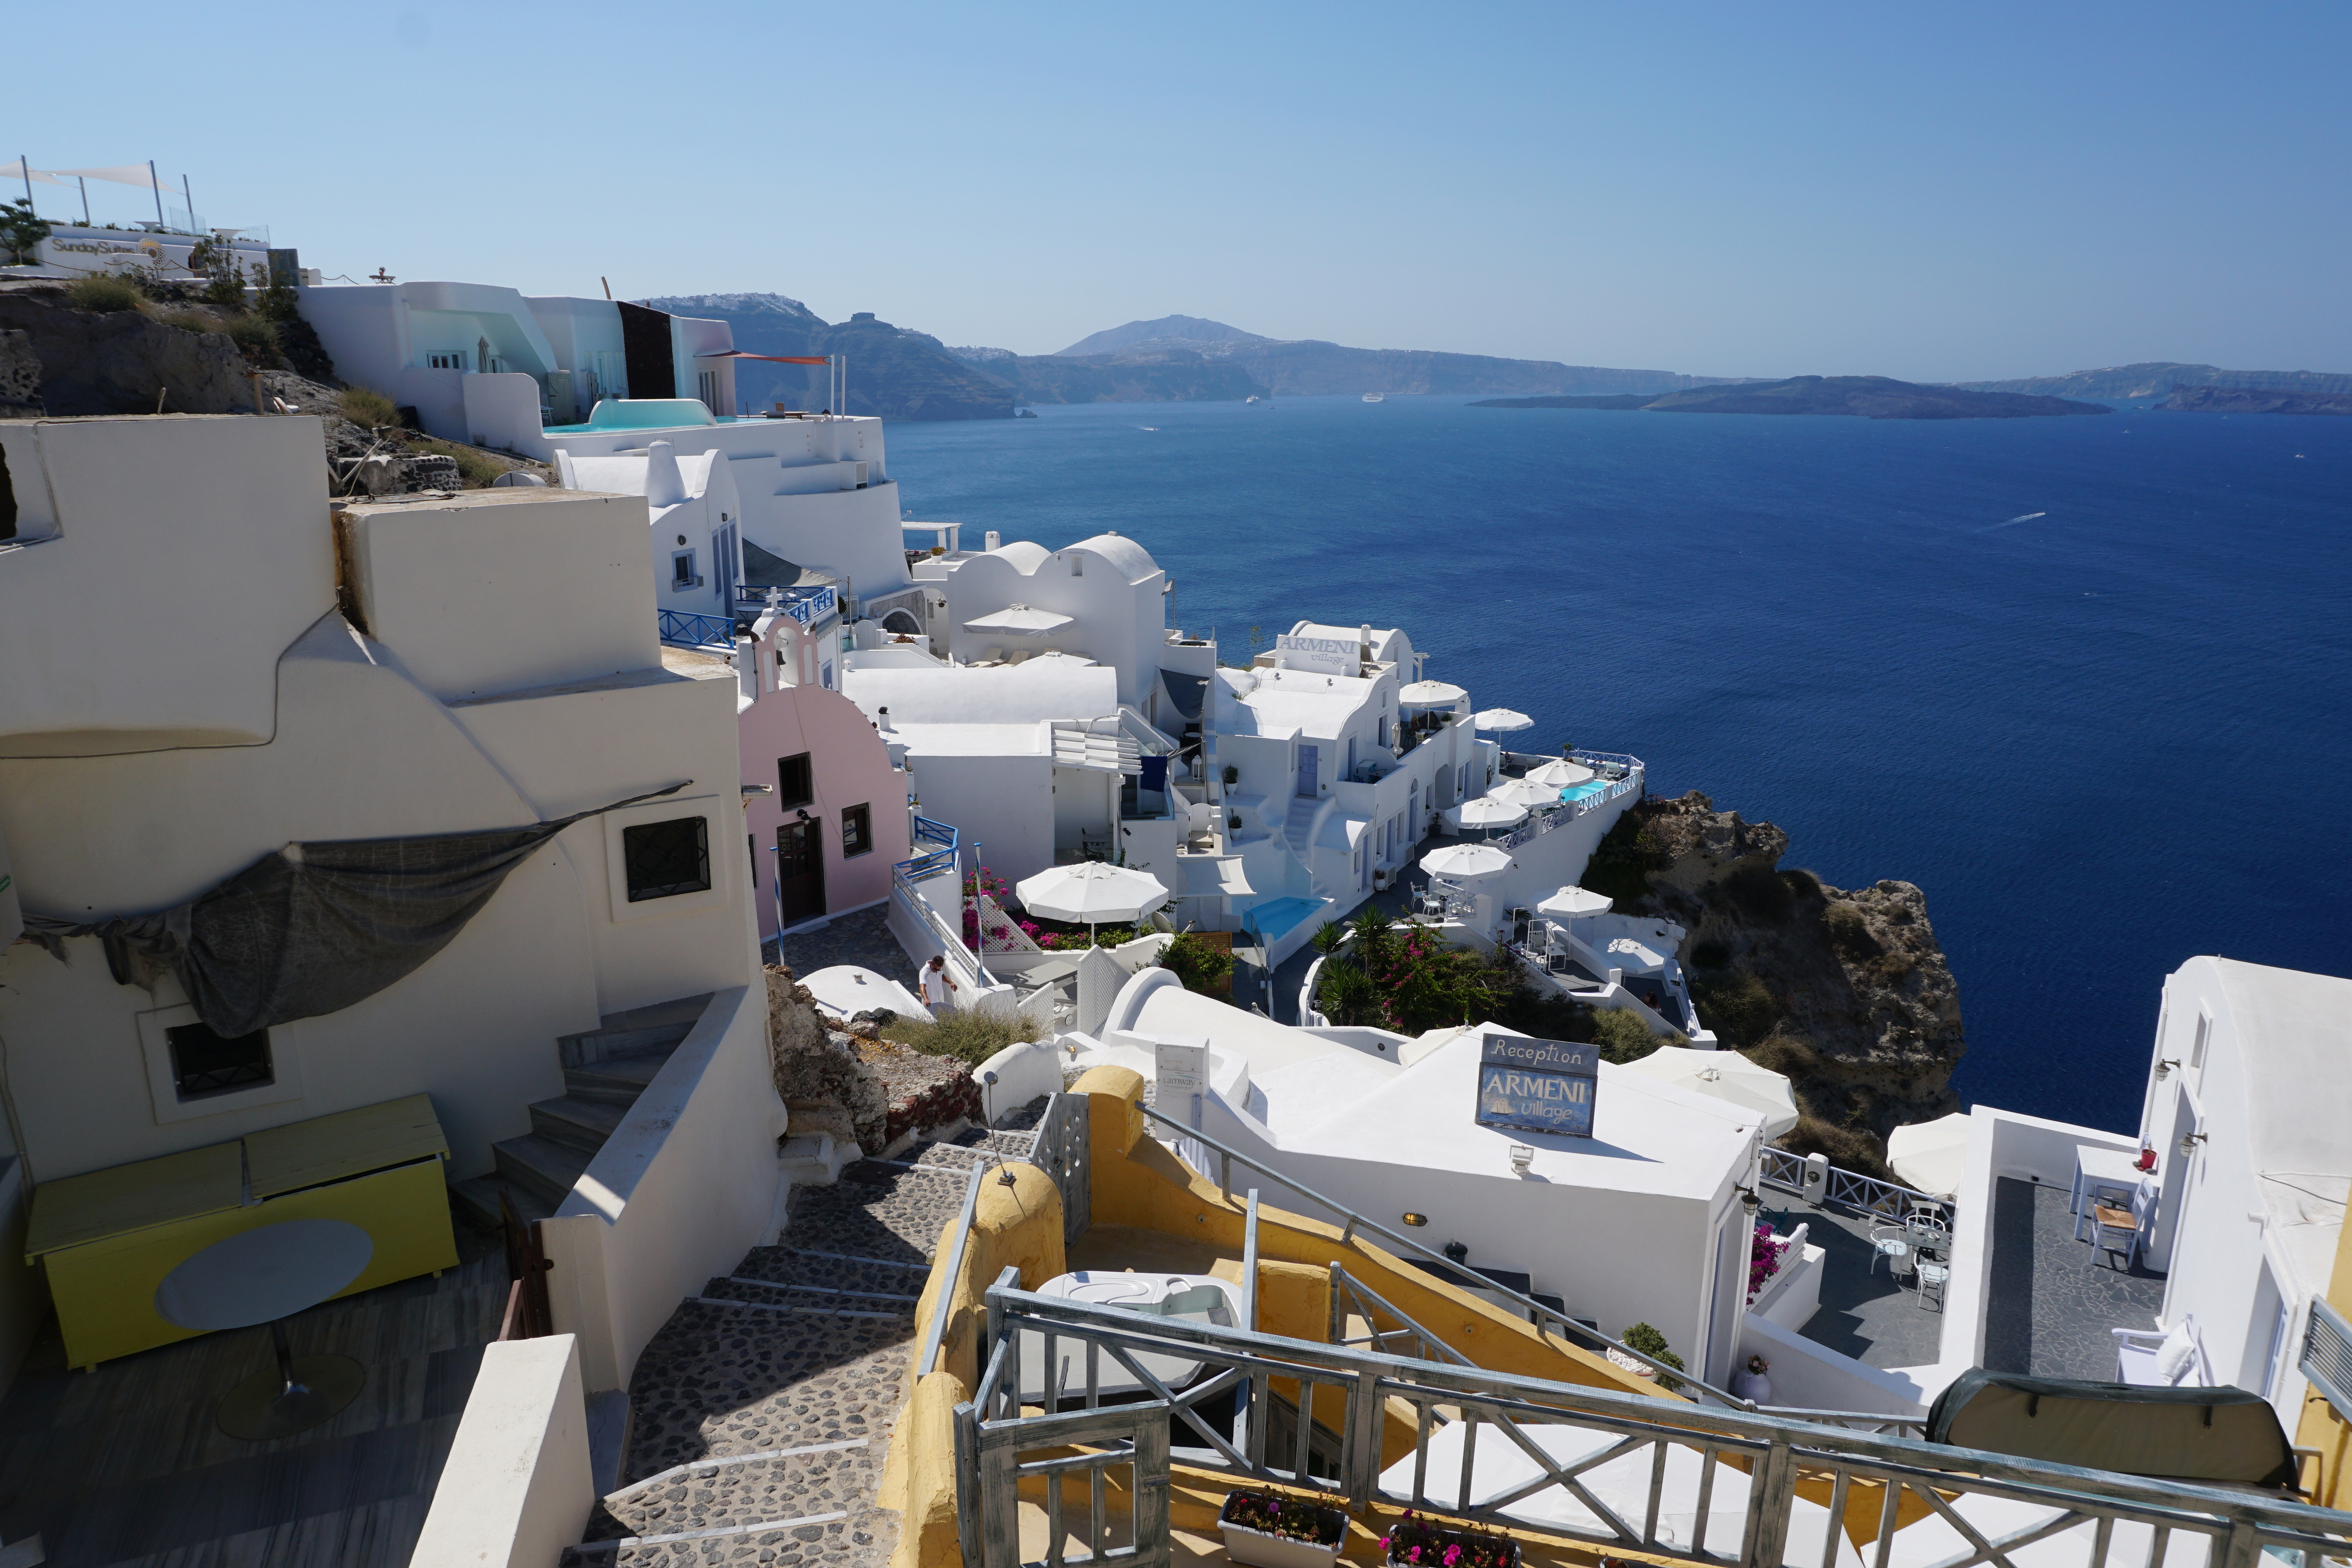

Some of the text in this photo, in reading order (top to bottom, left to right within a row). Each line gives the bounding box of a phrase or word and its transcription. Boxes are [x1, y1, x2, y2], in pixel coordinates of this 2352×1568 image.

[1278, 637, 1357, 654] ARMENI
[1311, 653, 1344, 665] village
[1490, 1039, 1582, 1065] Reception
[1163, 1077, 1195, 1088] Lamway
[1485, 1074, 1586, 1104] ARMENI
[1521, 1100, 1572, 1124] village
